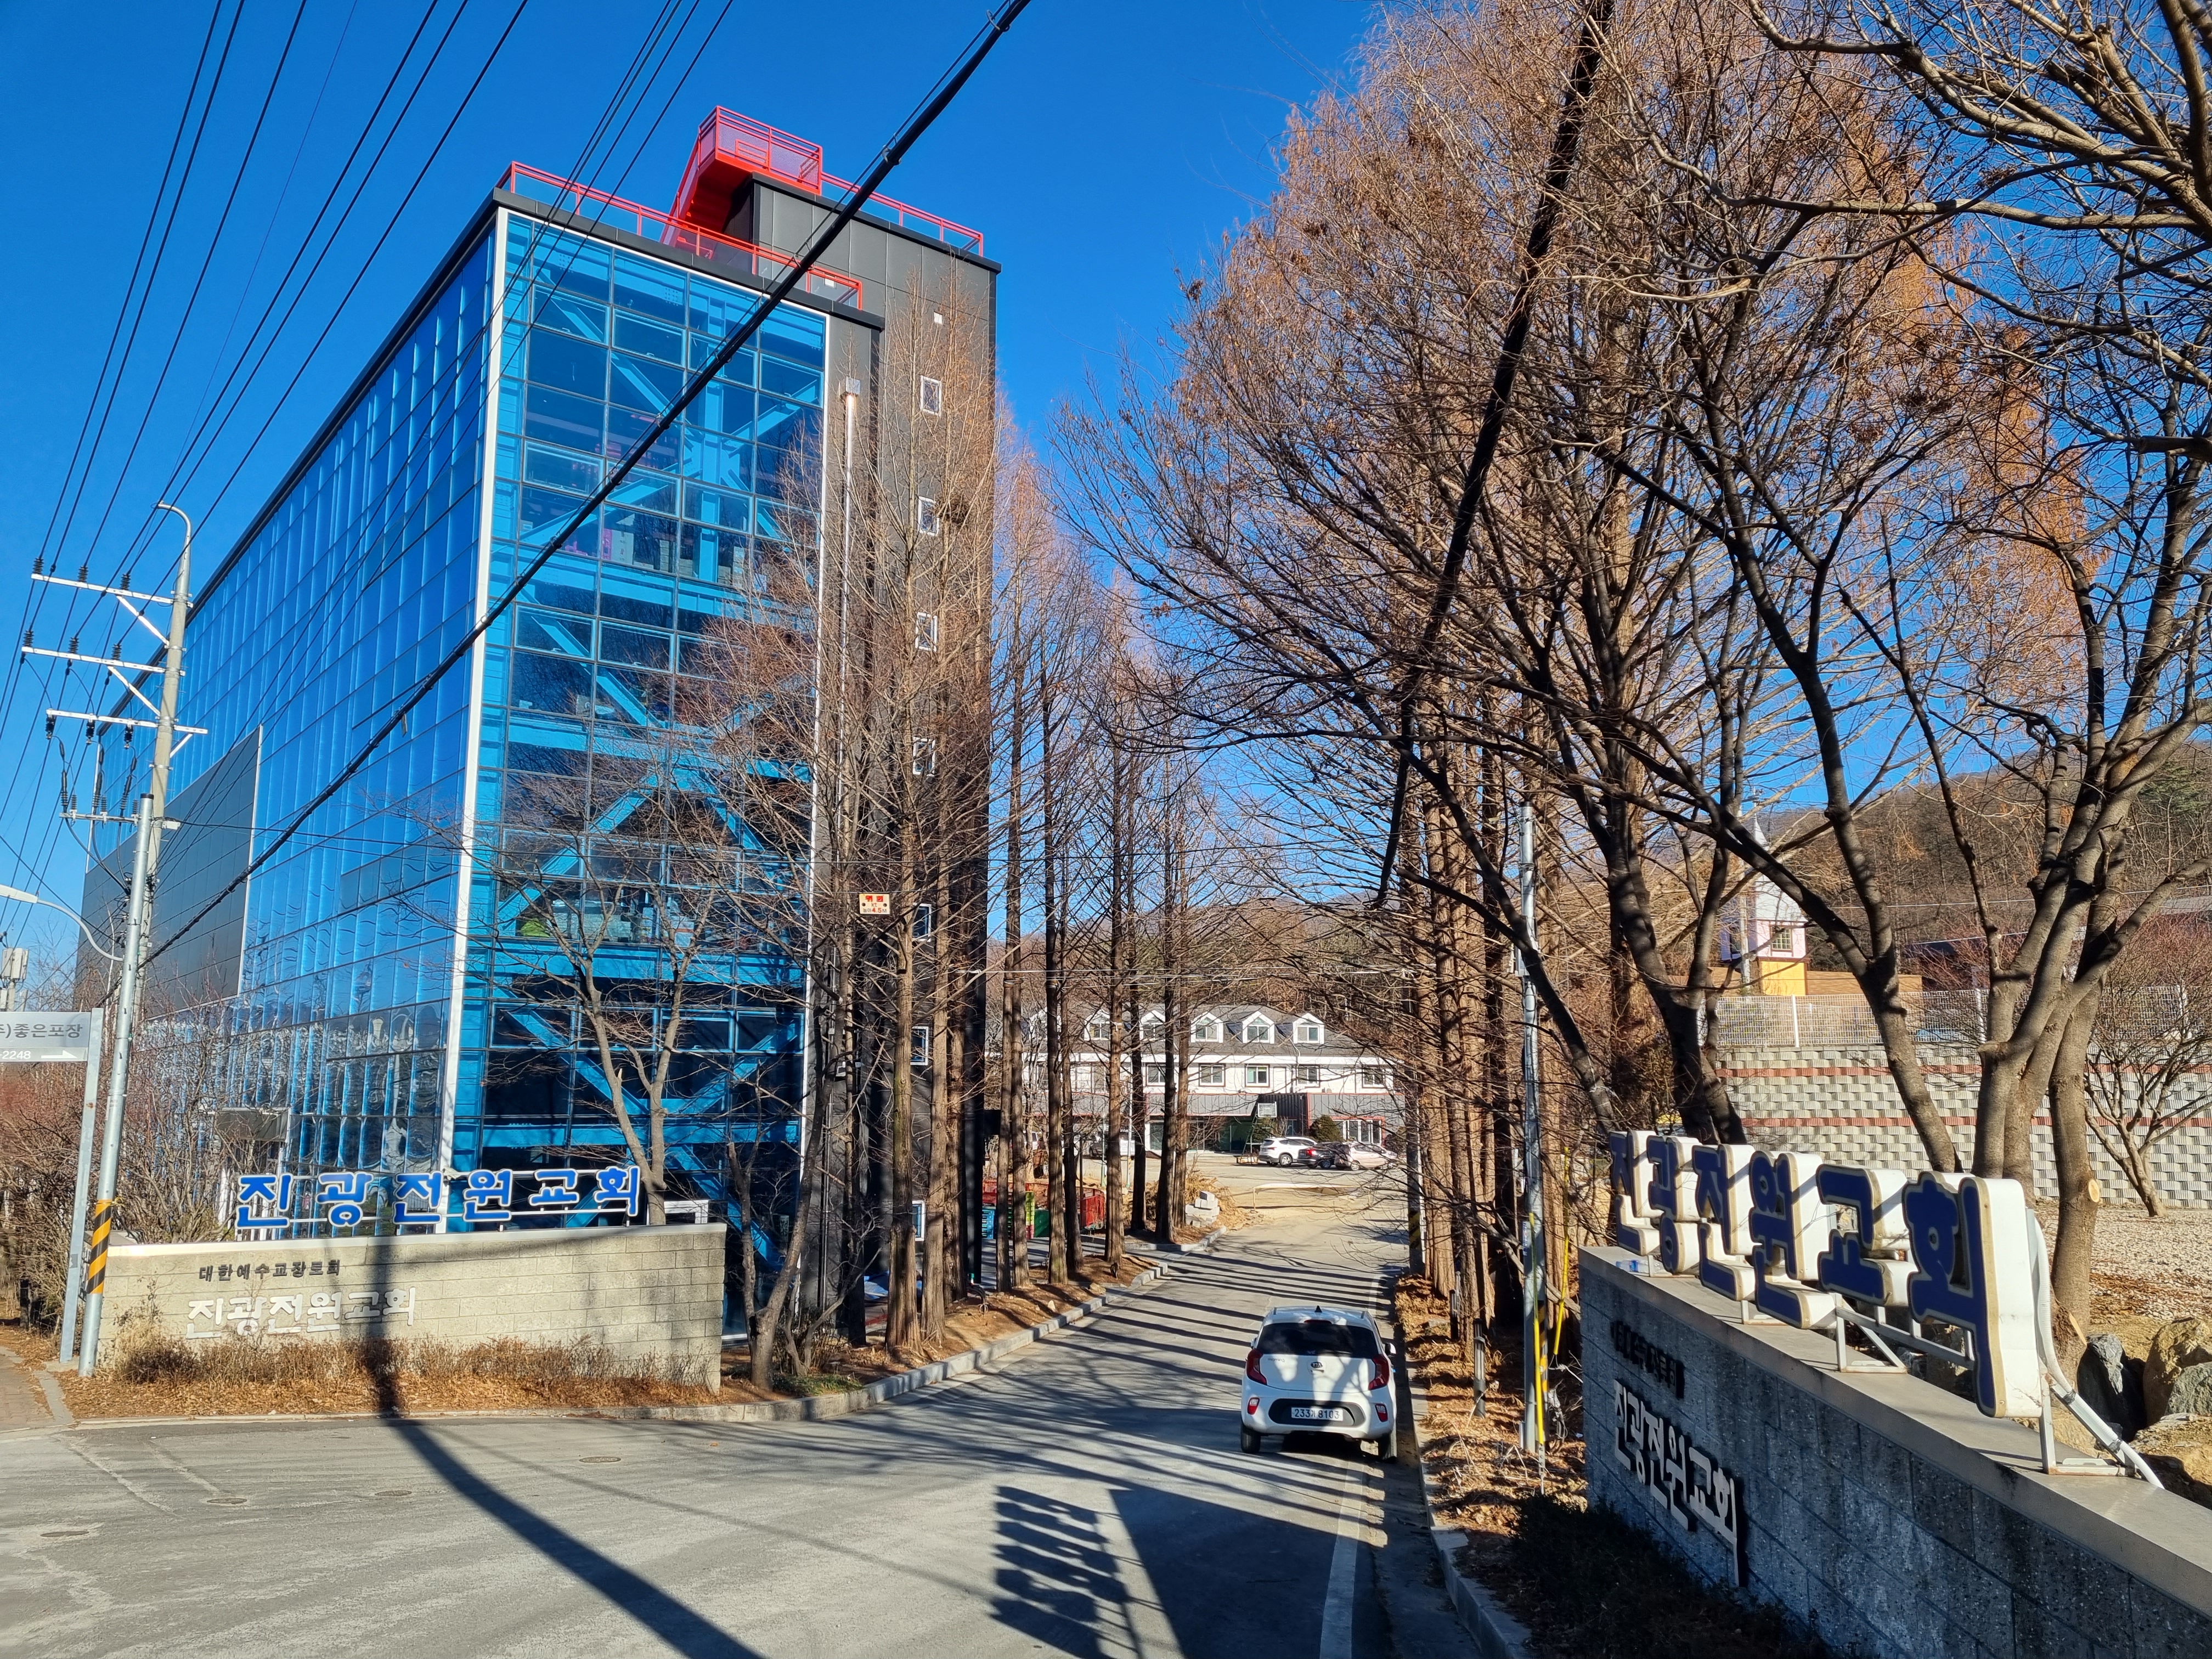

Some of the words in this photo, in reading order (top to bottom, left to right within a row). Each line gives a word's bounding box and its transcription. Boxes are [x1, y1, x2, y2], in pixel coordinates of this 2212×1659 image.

[236, 1165, 641, 1229] 진광전원교회
[199, 1259, 341, 1282] 대한예수교장로회
[1609, 1131, 2007, 1418] 진광전원교회
[185, 1286, 416, 1339] 진광전원교회
[1295, 1408, 1316, 1418] 233가
[1318, 1410, 1340, 1419] 8103
[1613, 1379, 1740, 1587] 진광전원교회
